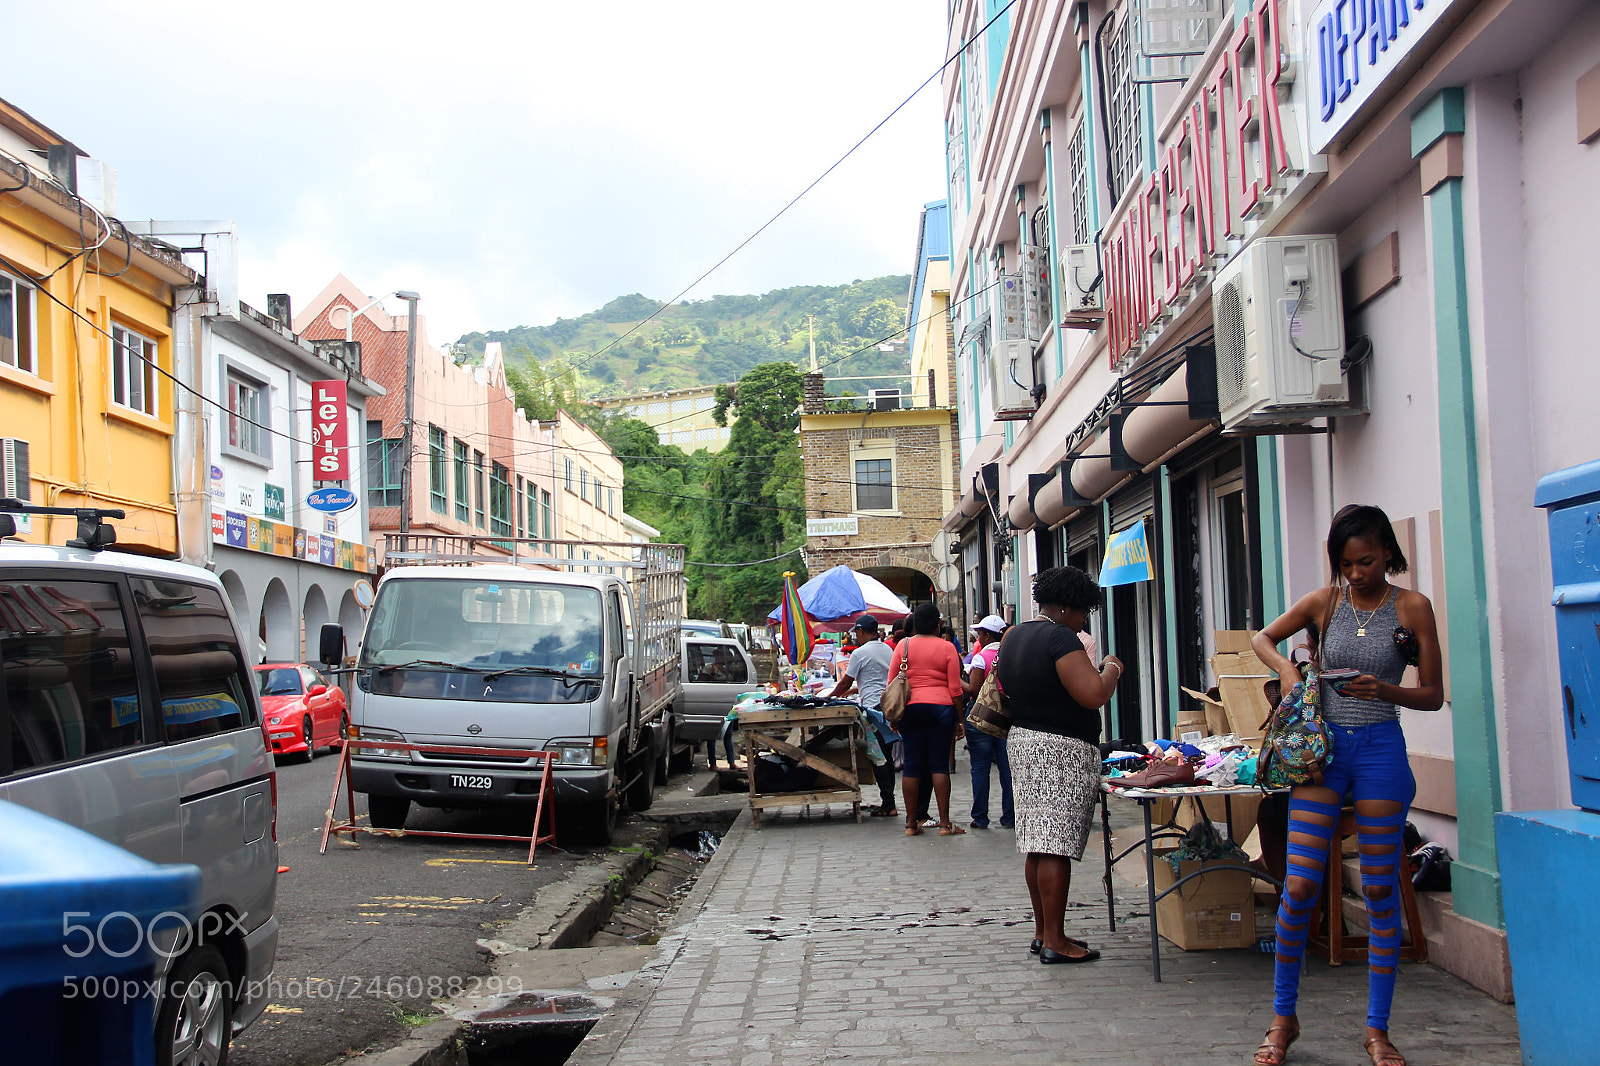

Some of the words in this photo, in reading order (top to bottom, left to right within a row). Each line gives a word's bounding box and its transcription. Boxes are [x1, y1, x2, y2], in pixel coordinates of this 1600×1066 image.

[308, 494, 325, 505] The
[326, 493, 353, 504] Trend
[451, 774, 493, 789] TN229
